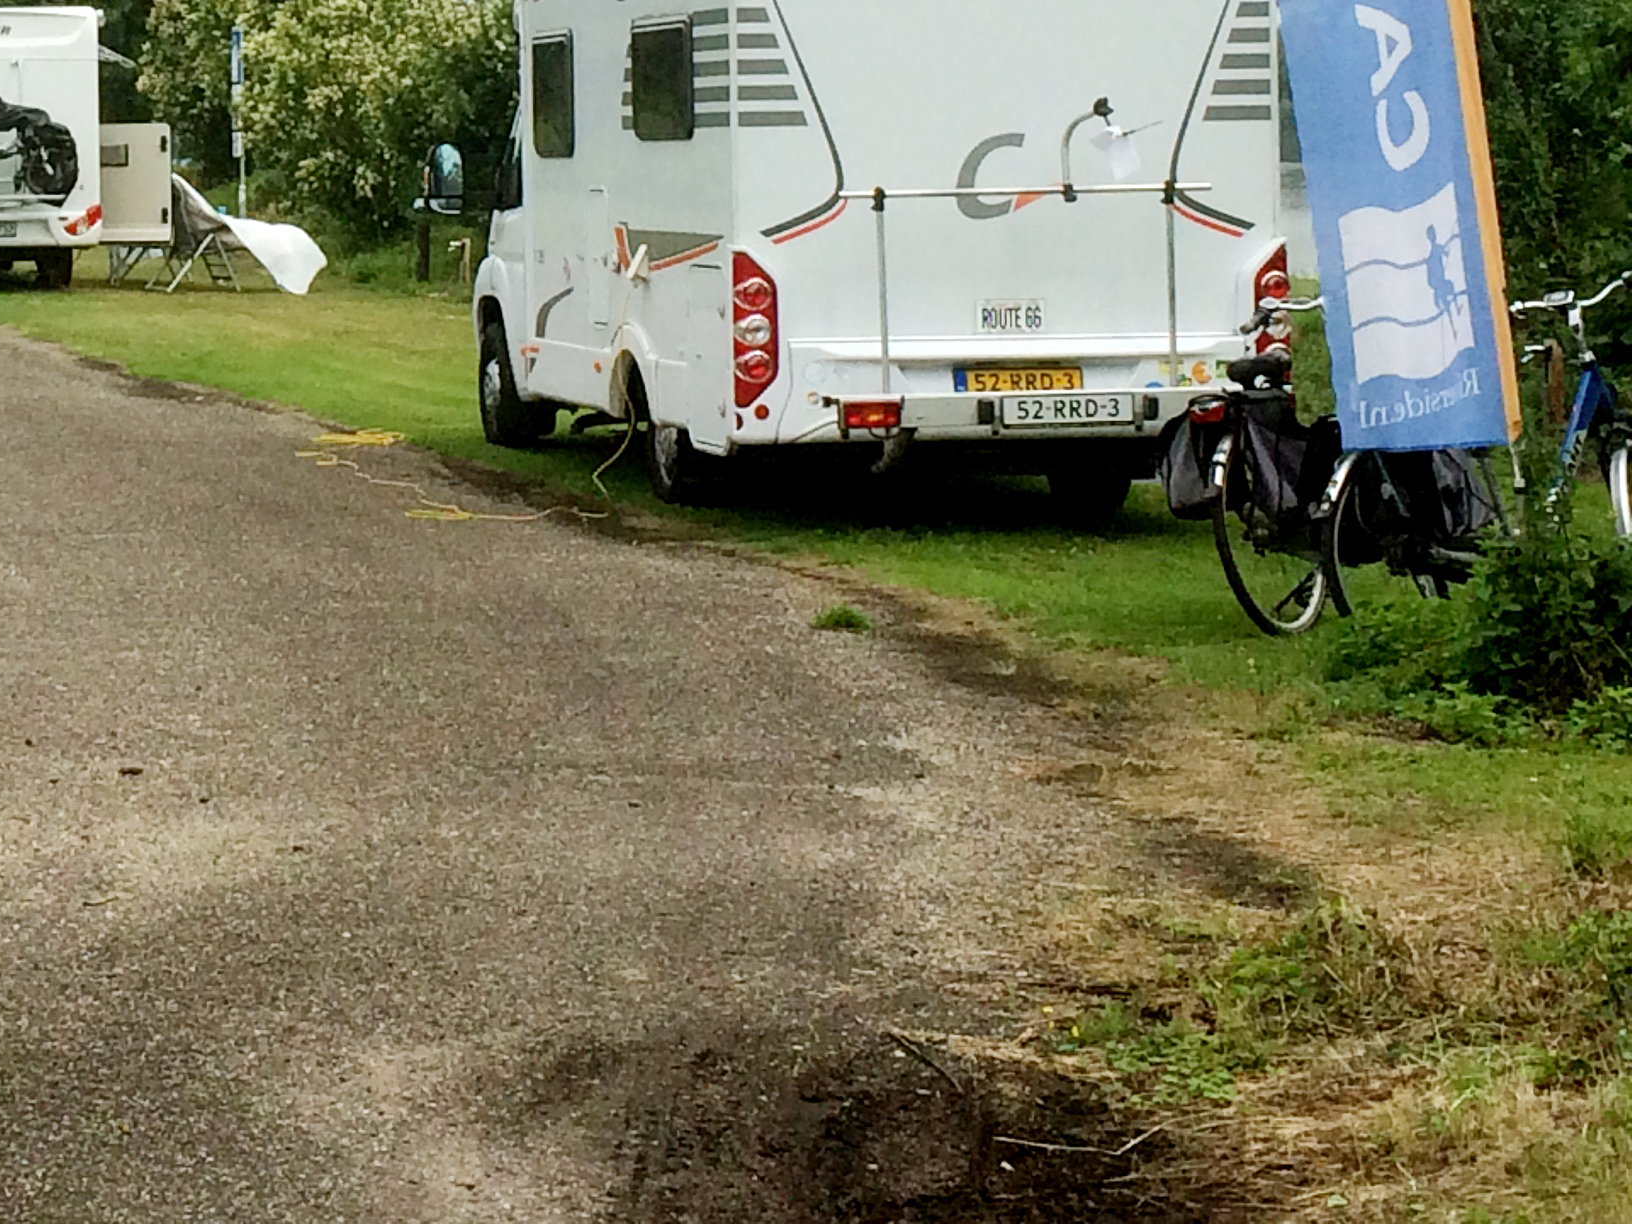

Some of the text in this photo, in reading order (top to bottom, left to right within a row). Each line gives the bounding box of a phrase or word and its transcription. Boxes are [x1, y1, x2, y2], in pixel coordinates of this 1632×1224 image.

[981, 306, 1042, 330] ROUTE 66
[973, 372, 1075, 391] 52-RRD-3
[1017, 398, 1120, 420] 52-RRD-3
